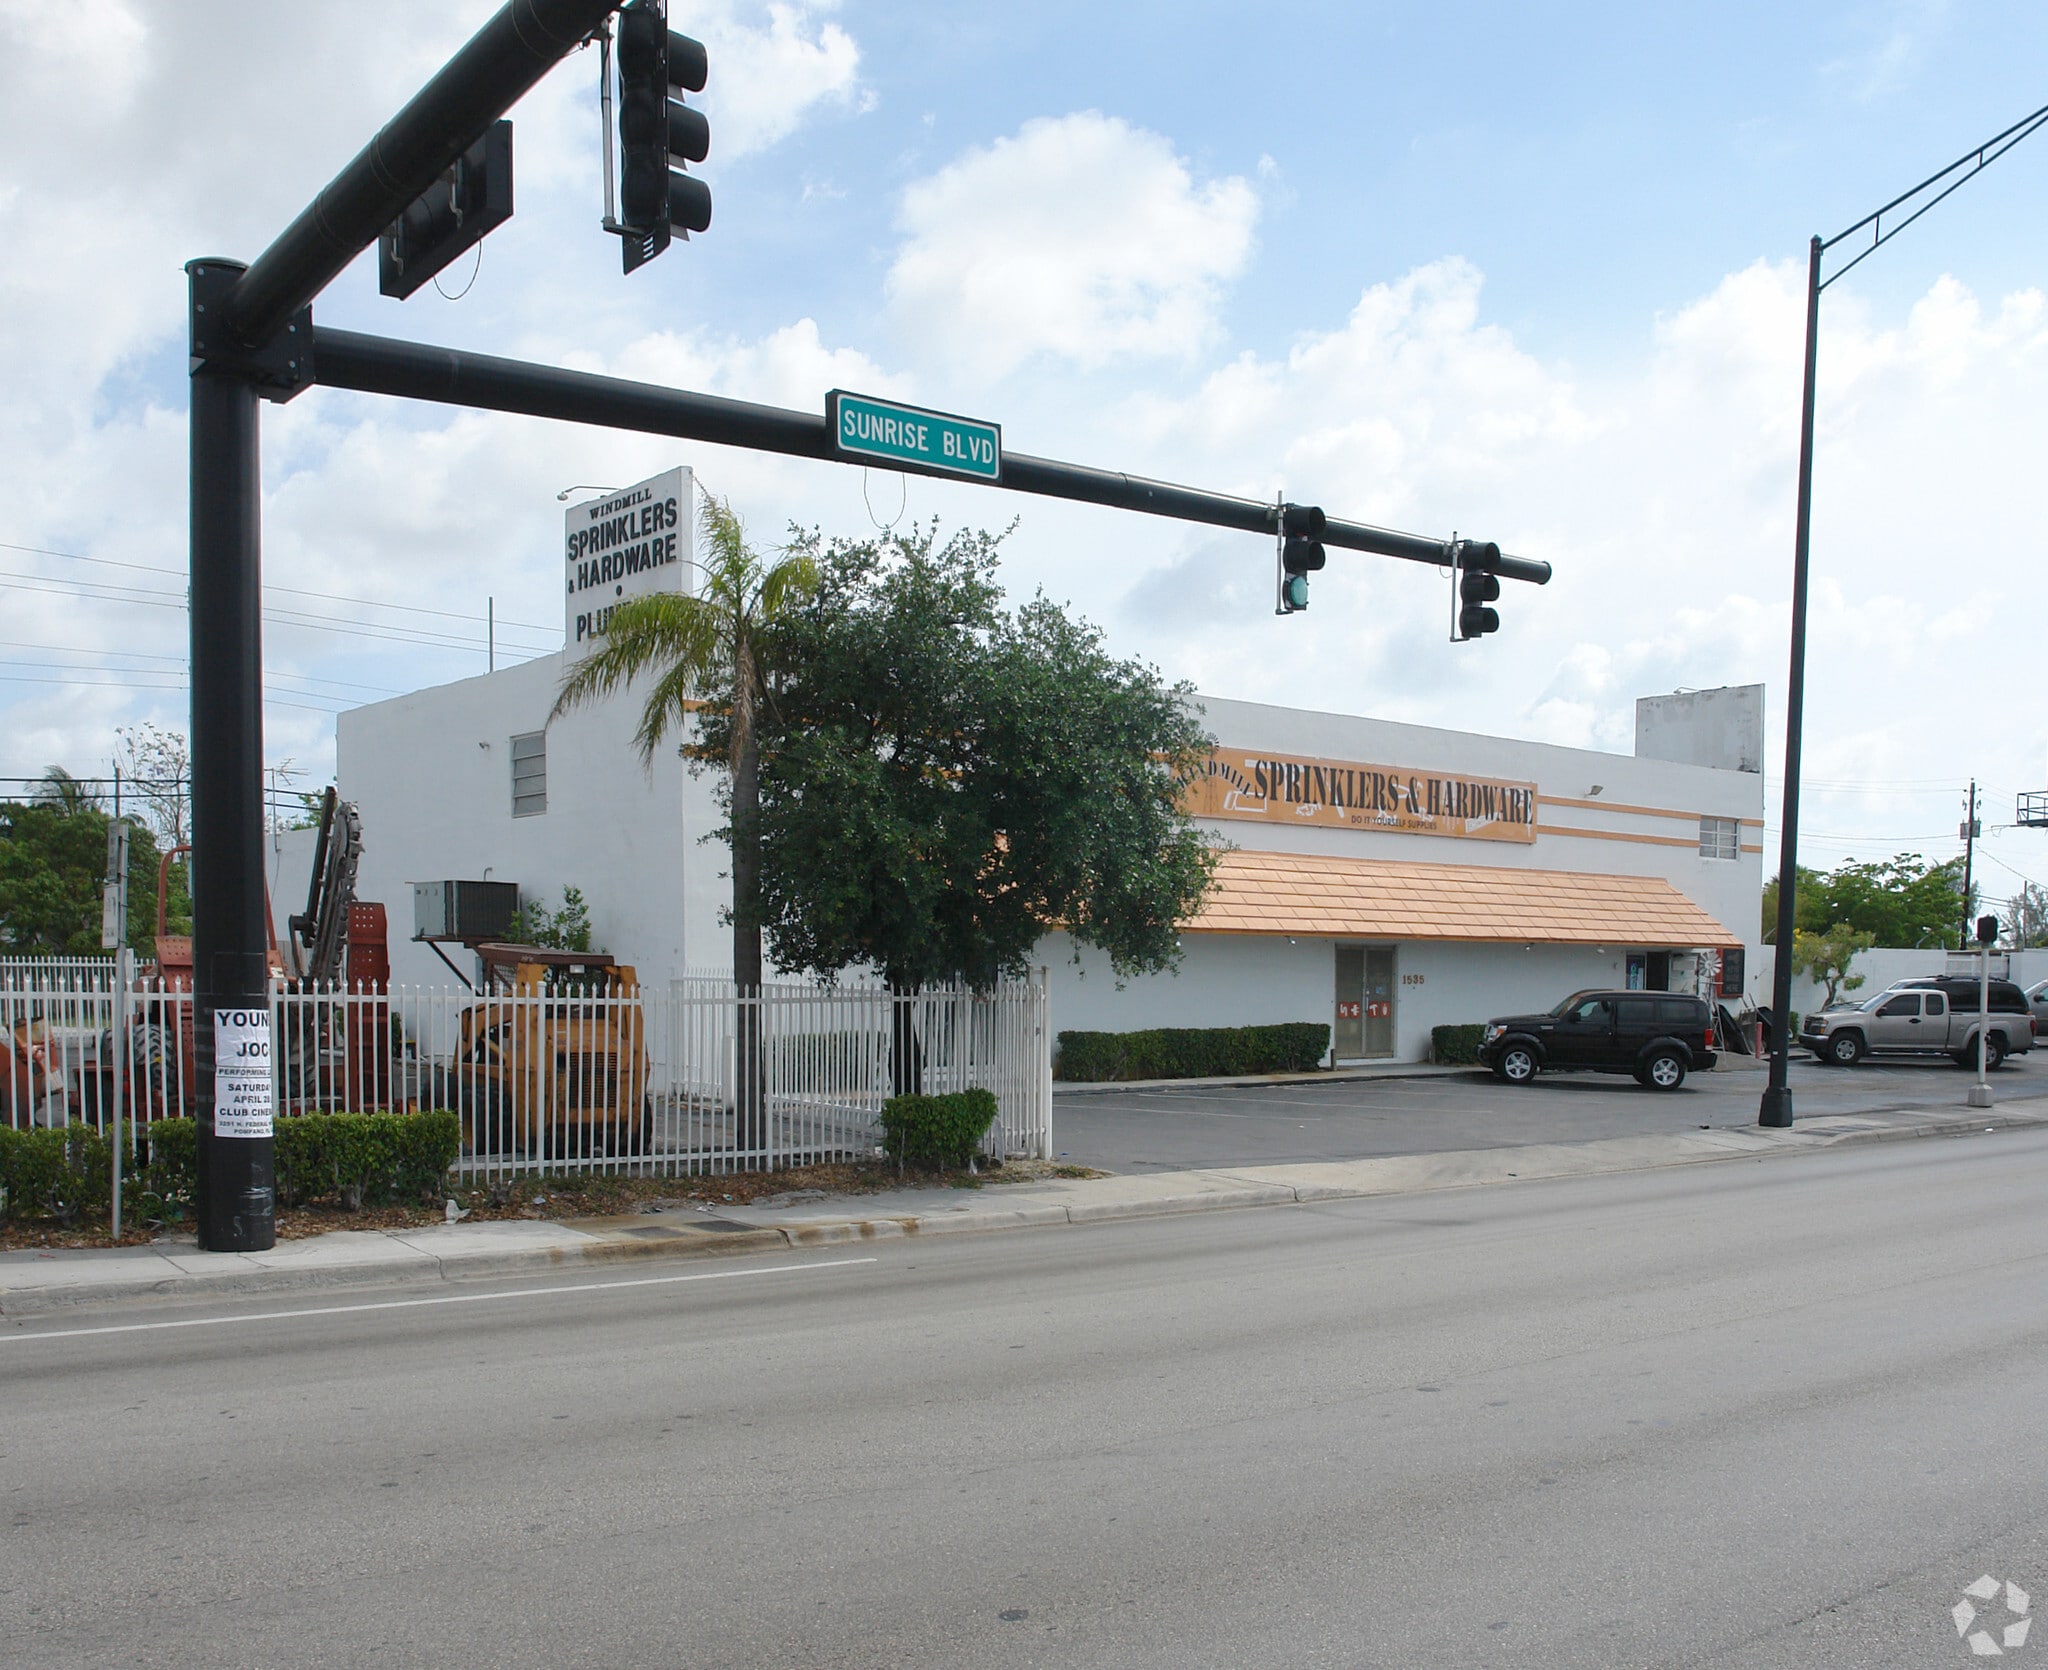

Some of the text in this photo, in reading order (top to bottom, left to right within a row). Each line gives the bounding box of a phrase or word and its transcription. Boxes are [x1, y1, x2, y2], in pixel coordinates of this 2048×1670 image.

[844, 409, 993, 464] SUNRISE BLVD
[589, 488, 652, 520] WINDMILL
[568, 497, 677, 561] SPRINKLERS
[568, 533, 677, 594] & HARDWARE
[1255, 759, 1533, 825] SPRINKLERS & HARDWARE
[1351, 815, 1437, 830] DO IT YOURSELF SUPPLIES
[1402, 974, 1425, 985] 1535
[227, 1083, 271, 1092] SATURDA
[233, 1095, 262, 1104] APRIL
[219, 1107, 249, 1117] CLUB
